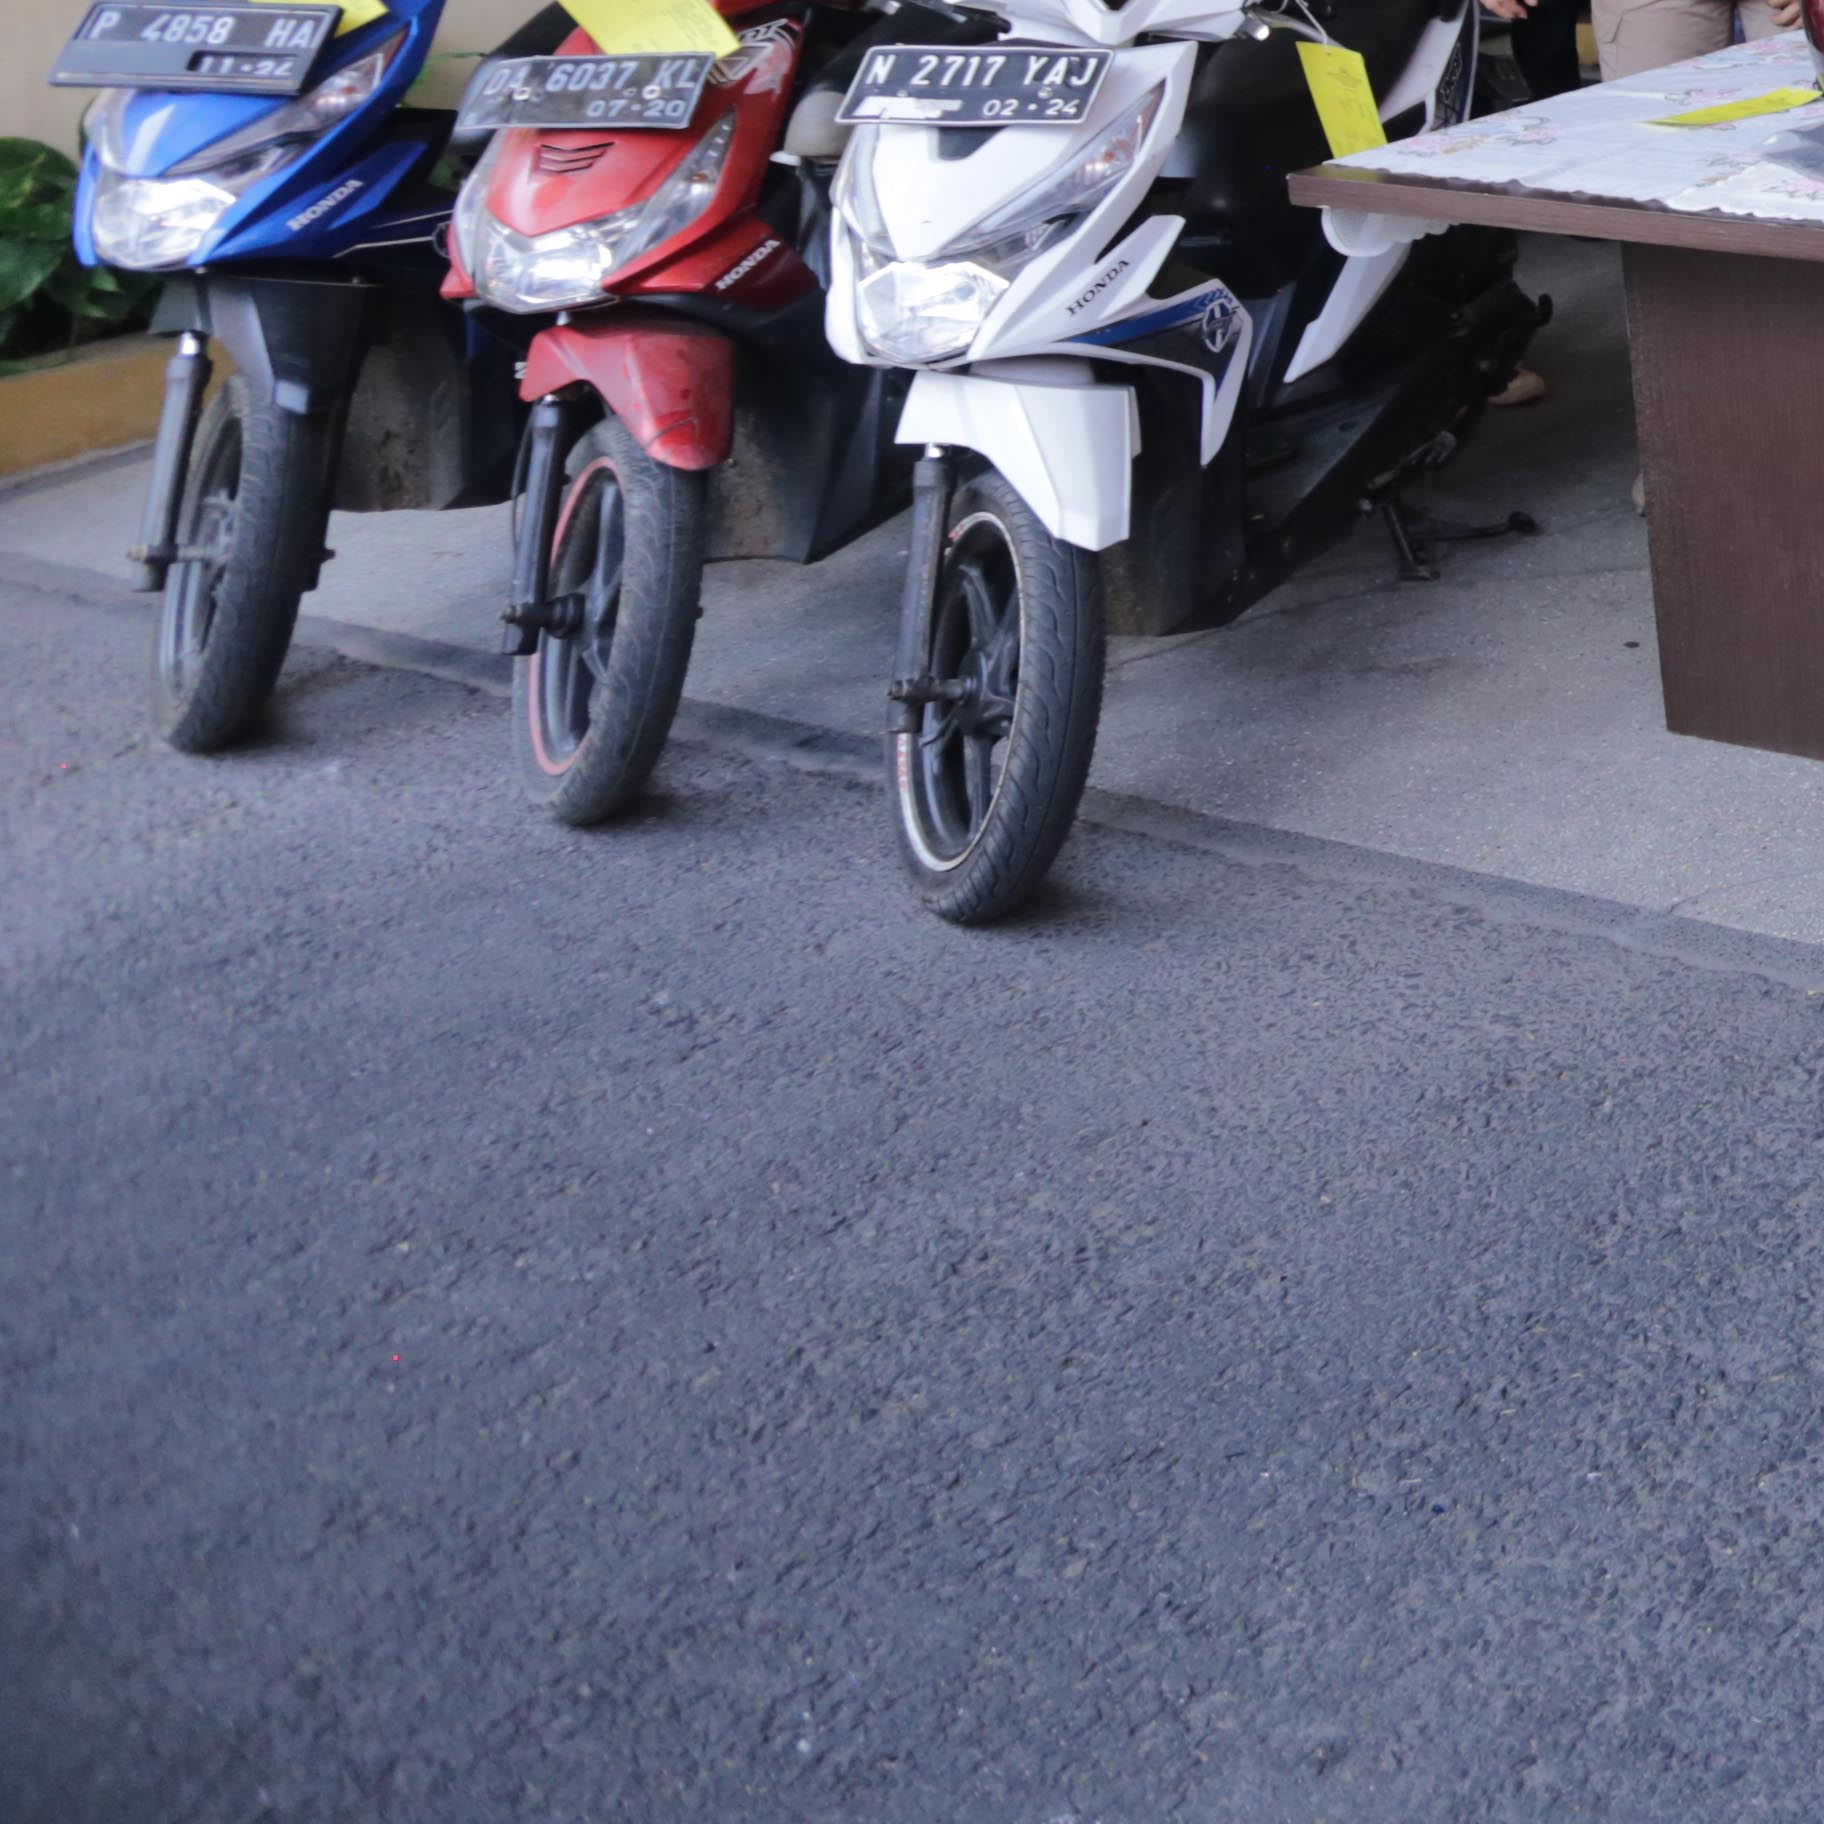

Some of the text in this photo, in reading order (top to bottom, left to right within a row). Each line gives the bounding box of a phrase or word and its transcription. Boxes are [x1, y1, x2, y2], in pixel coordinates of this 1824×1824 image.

[89, 10, 316, 49] P 4858 HA
[545, 61, 639, 92] 6037
[651, 58, 700, 89] KL
[865, 54, 1098, 87] N 2717 YAJ
[287, 179, 363, 232] HONDA
[715, 237, 780, 290] HONDA
[1065, 257, 1132, 318] HONDA
